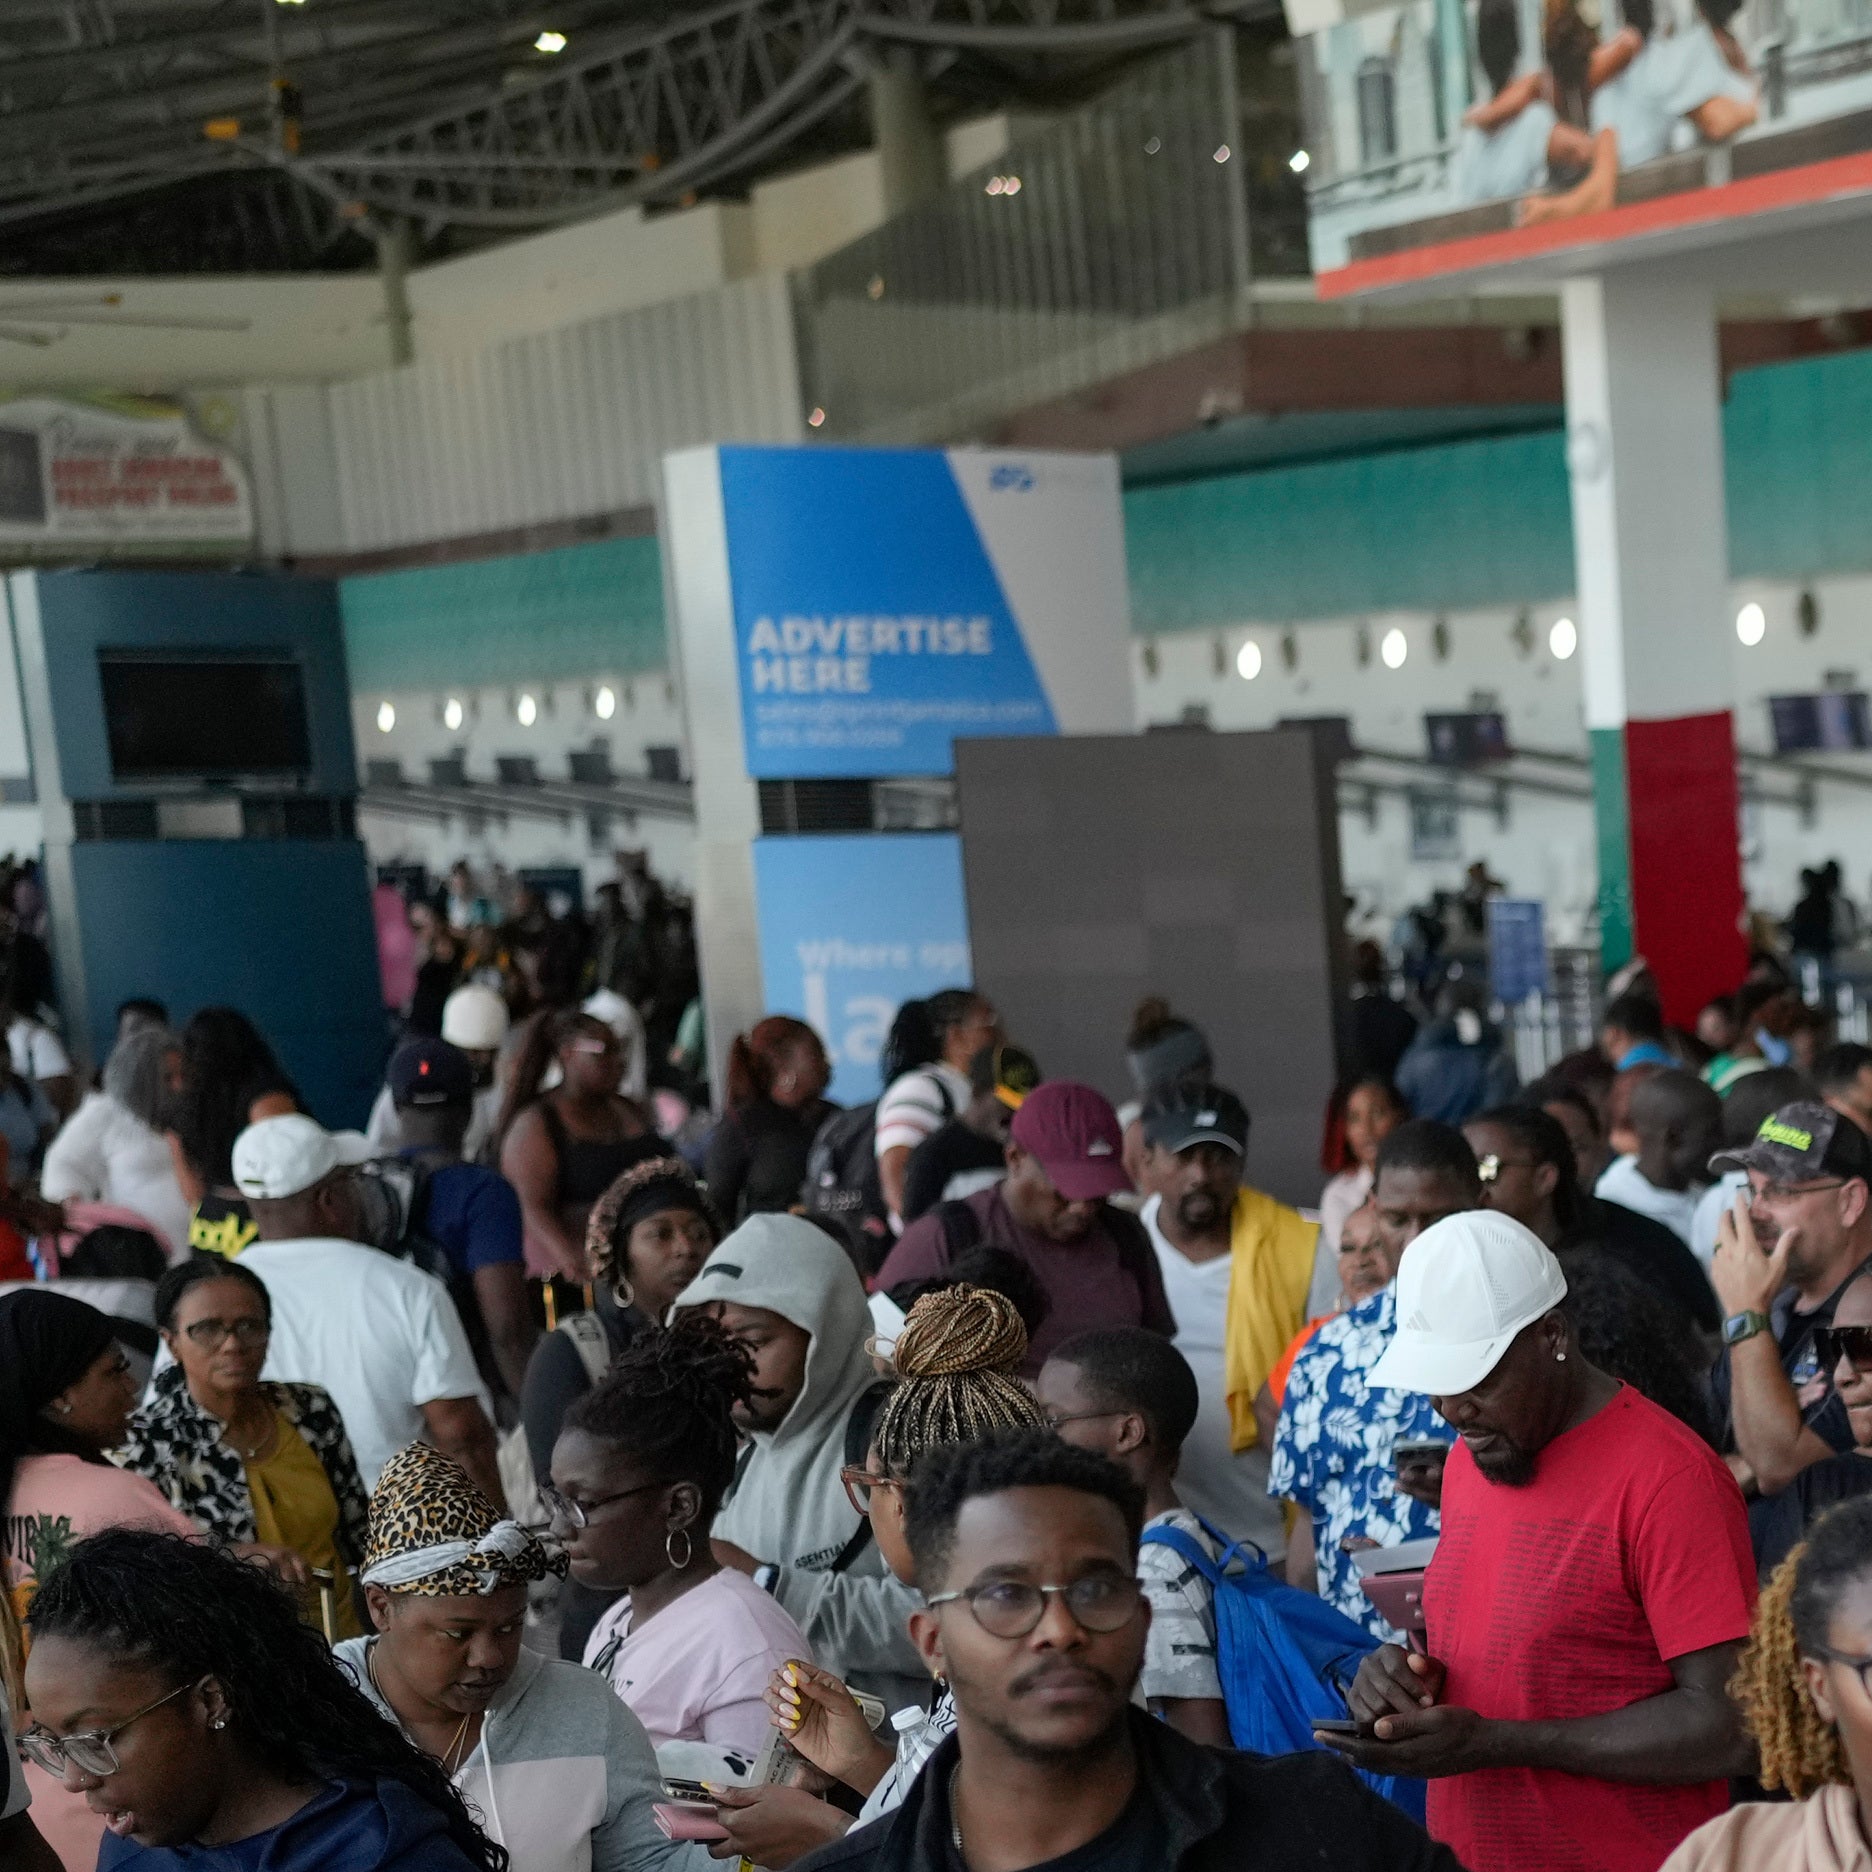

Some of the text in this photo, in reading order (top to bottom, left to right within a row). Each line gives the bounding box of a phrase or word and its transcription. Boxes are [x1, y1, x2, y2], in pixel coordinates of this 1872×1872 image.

[750, 615, 993, 655] ADVERTISE
[752, 655, 872, 693] HERE
[797, 939, 910, 968] Where
